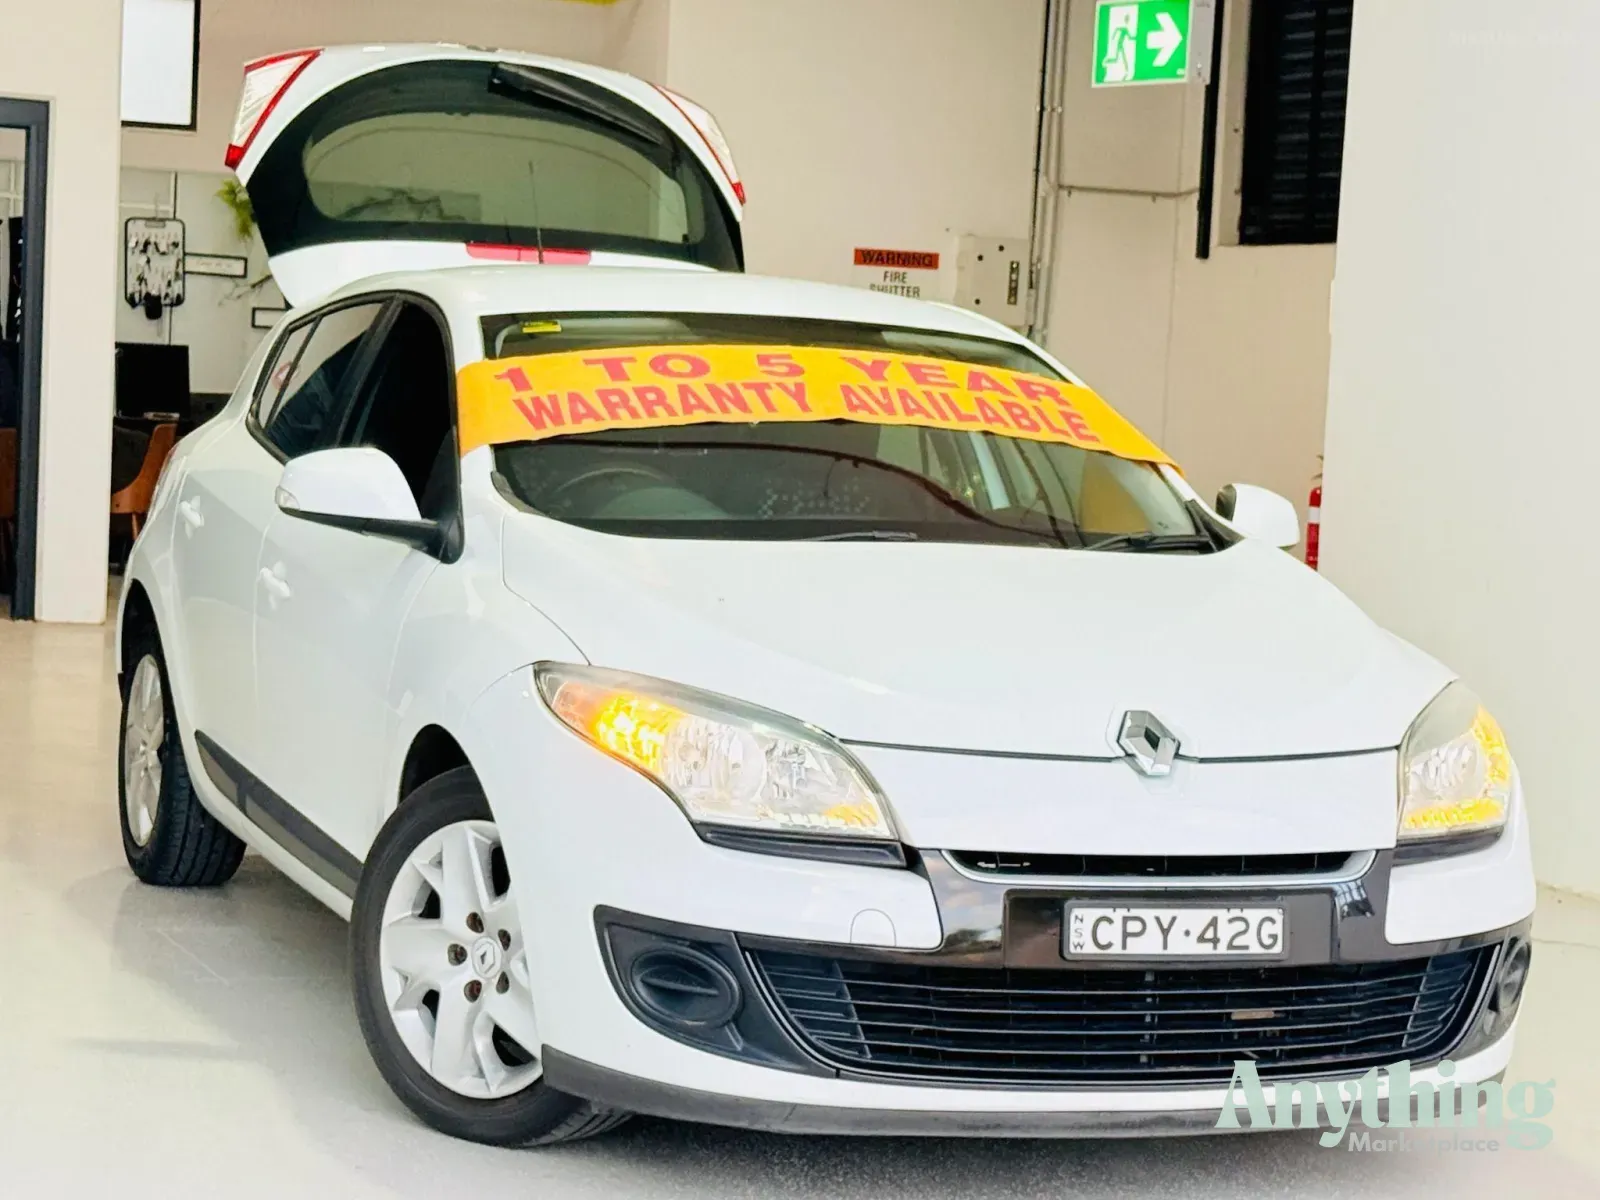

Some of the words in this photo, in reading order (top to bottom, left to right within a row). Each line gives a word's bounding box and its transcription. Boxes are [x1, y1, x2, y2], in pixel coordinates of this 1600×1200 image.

[862, 250, 932, 267] WARNING
[883, 271, 907, 283] FIRE
[495, 367, 533, 392] 1
[583, 354, 710, 381] TO
[756, 354, 805, 377] 5
[839, 357, 1071, 405] YEAR
[512, 382, 813, 431] WARRANTY
[840, 384, 1100, 442] AVAILABLE
